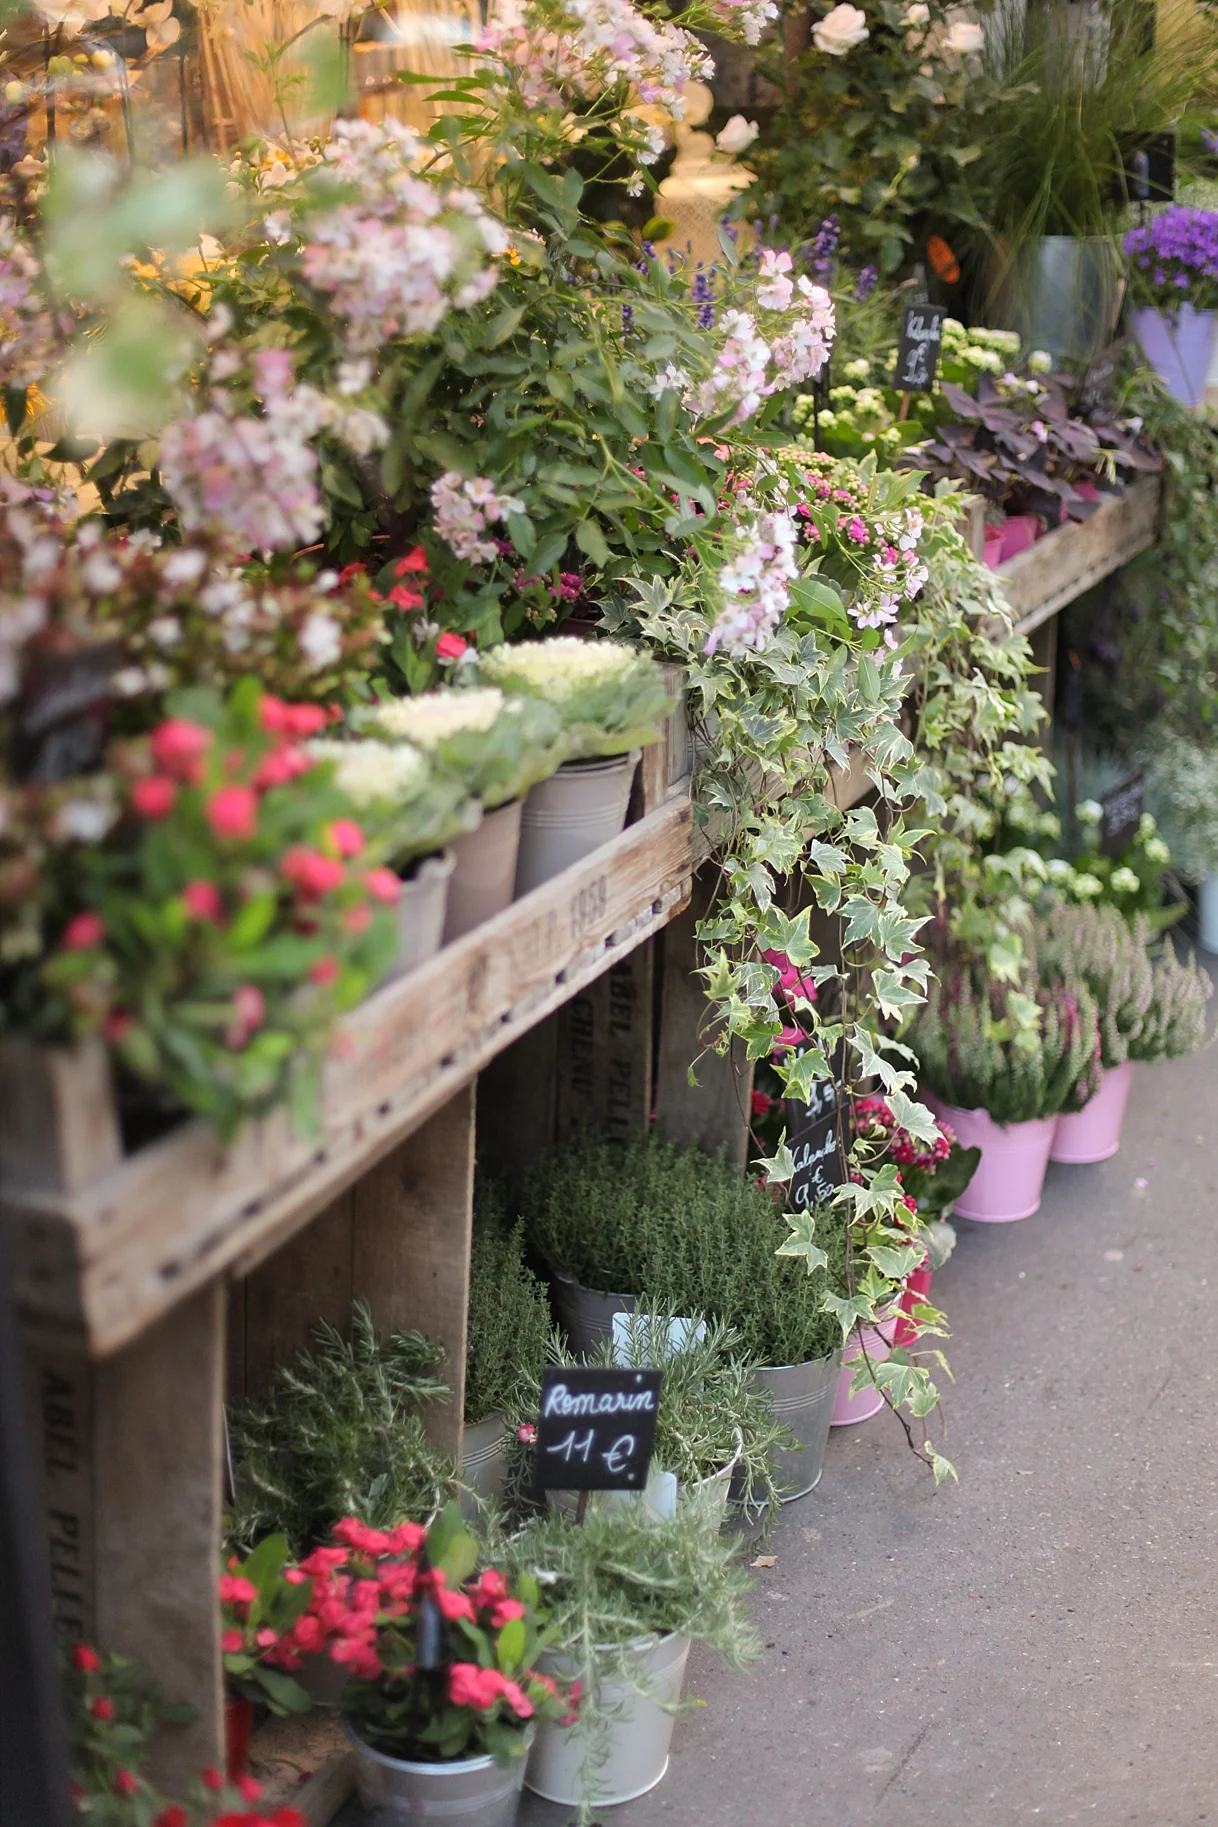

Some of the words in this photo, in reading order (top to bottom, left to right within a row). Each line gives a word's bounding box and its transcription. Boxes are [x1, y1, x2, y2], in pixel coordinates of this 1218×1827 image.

[544, 1383, 655, 1418] Romarin
[546, 1429, 594, 1463] 11
[602, 1434, 635, 1473] €
